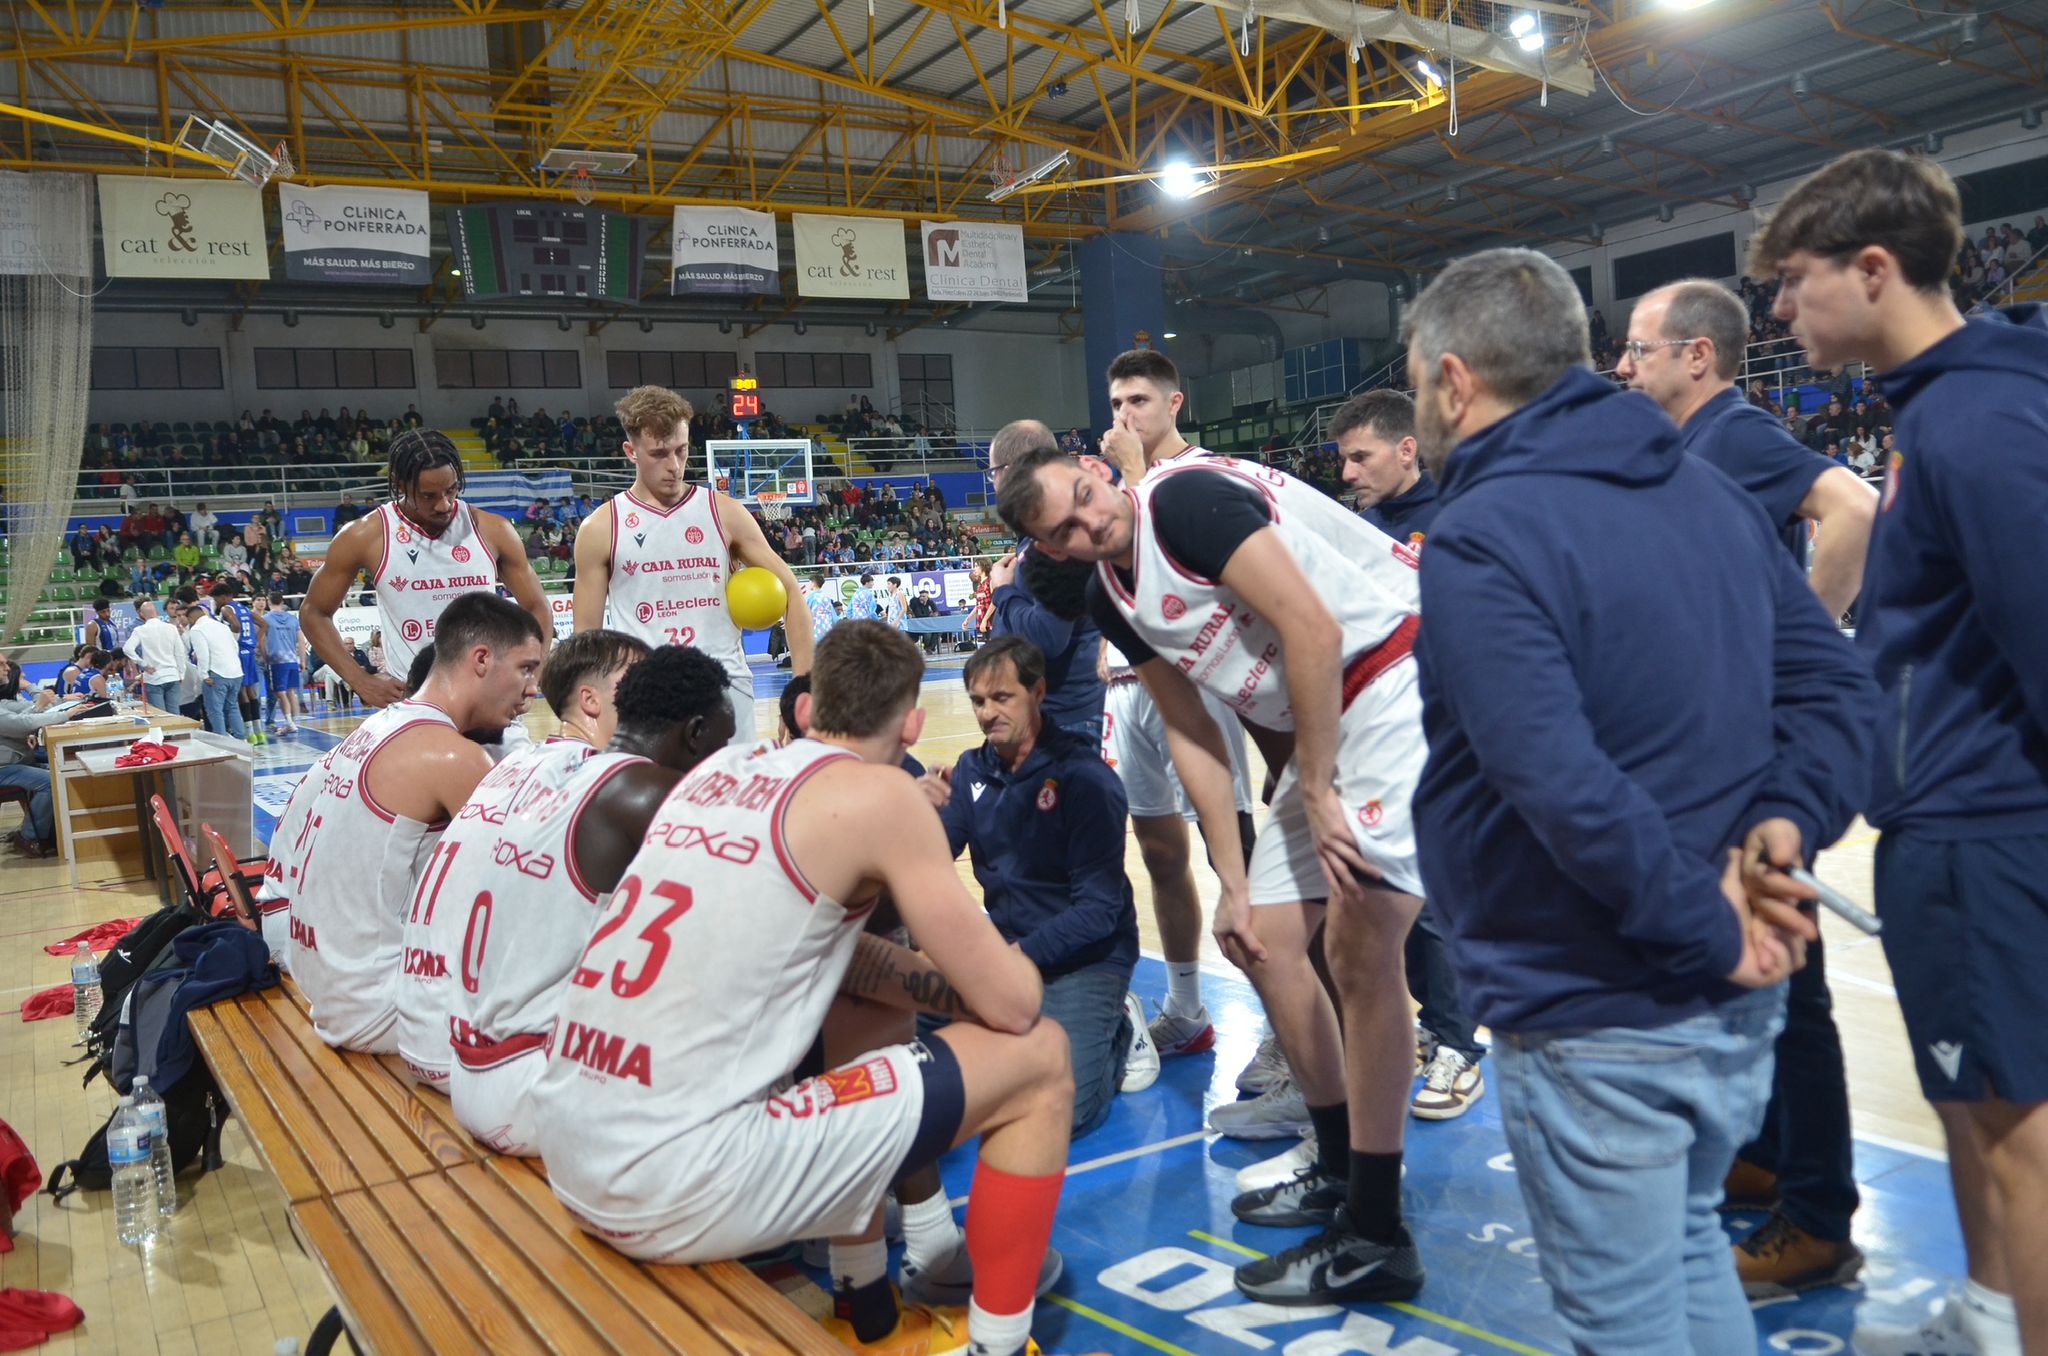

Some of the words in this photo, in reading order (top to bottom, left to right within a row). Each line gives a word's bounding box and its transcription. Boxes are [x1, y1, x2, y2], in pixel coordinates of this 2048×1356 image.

[324, 220, 427, 235] PONFERRADA
[120, 238, 159, 253] cat
[207, 240, 250, 256] rest
[692, 238, 774, 250] PONFERRADA
[961, 240, 992, 250] Esthetic
[962, 249, 987, 259] Dental
[303, 257, 325, 266] MÁS
[326, 258, 359, 268] SALUD.
[360, 259, 381, 269] MÁS
[963, 261, 999, 271] Academy
[695, 272, 722, 280] SALUD.
[807, 265, 833, 279] cat
[866, 267, 897, 281] rest
[929, 272, 976, 286] Clínica
[980, 274, 1023, 288] Dental
[733, 394, 758, 416] 24
[641, 560, 674, 573] CAJA
[677, 557, 720, 570] RURAL
[411, 580, 446, 591] CAJA
[448, 575, 490, 588] RURAL
[655, 597, 720, 612] E.Leclerc
[1189, 602, 1236, 657] RURAL
[410, 840, 462, 926] 11
[462, 890, 493, 994] 0
[572, 874, 694, 999] 23
[560, 1020, 652, 1088] IXMA
